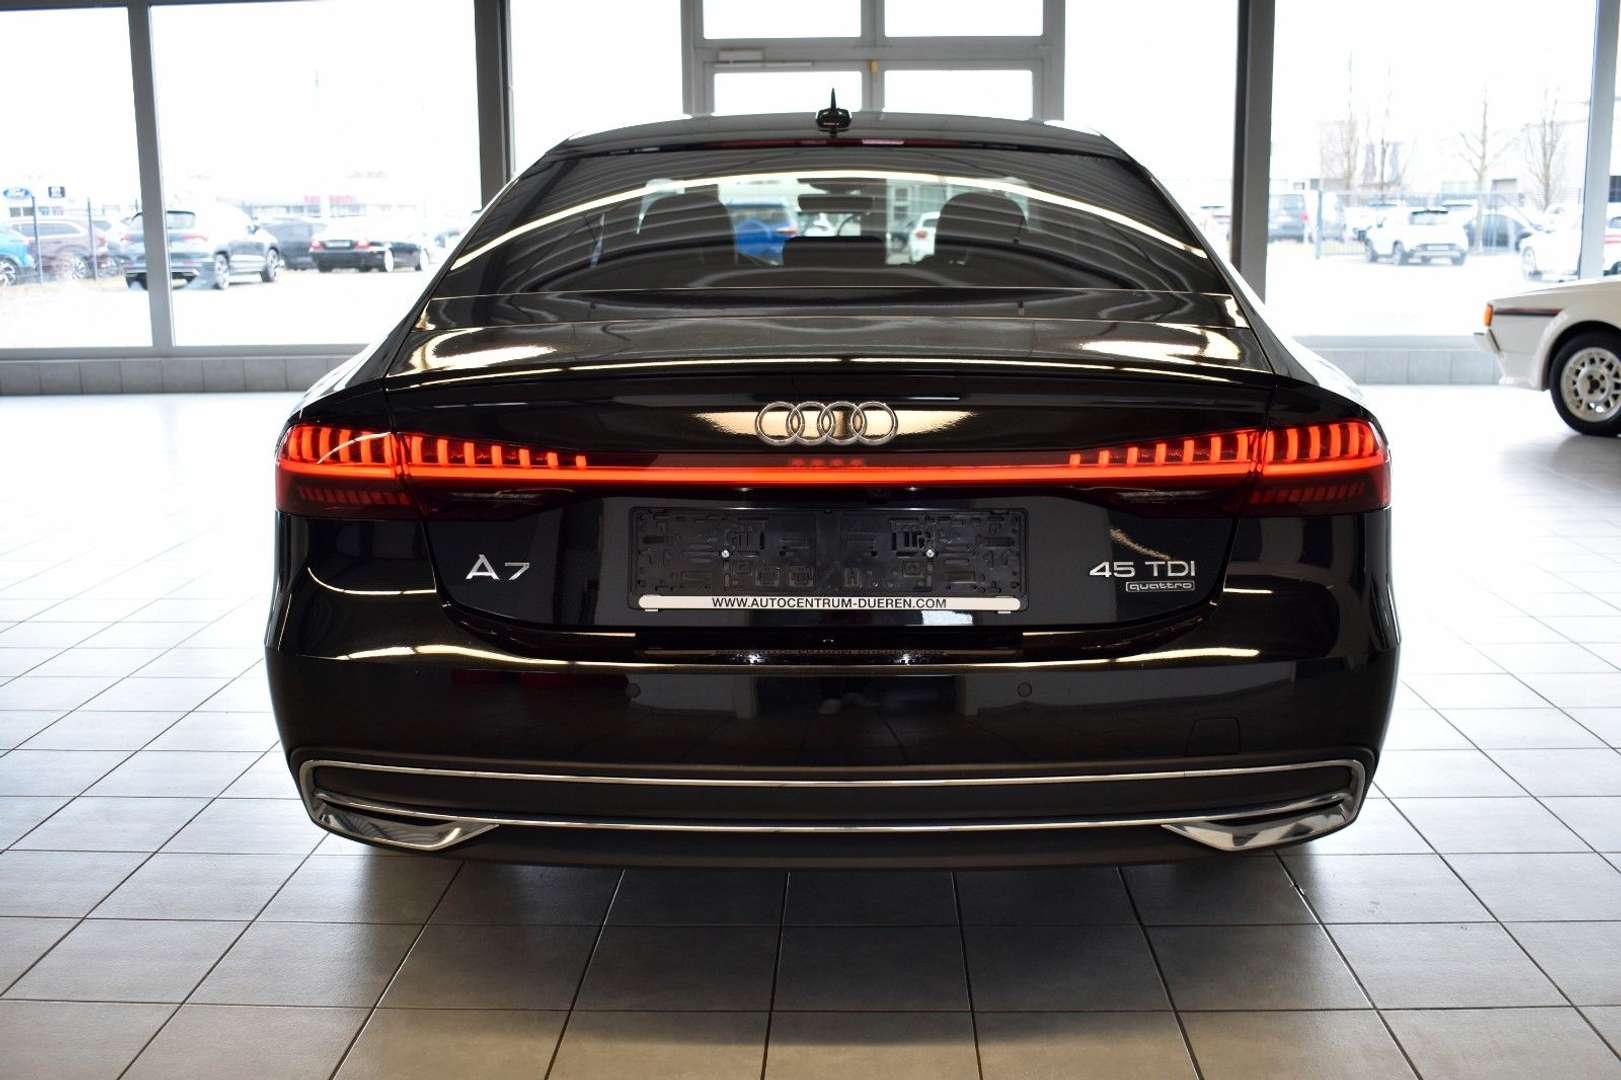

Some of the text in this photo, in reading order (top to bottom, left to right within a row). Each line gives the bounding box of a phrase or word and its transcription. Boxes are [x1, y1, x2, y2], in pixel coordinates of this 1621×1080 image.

[1089, 560, 1196, 578] 45 TDI
[1128, 582, 1193, 591] quattro
[712, 596, 947, 610] WWW.AUTOCENTRUM-DUEREN.COM
